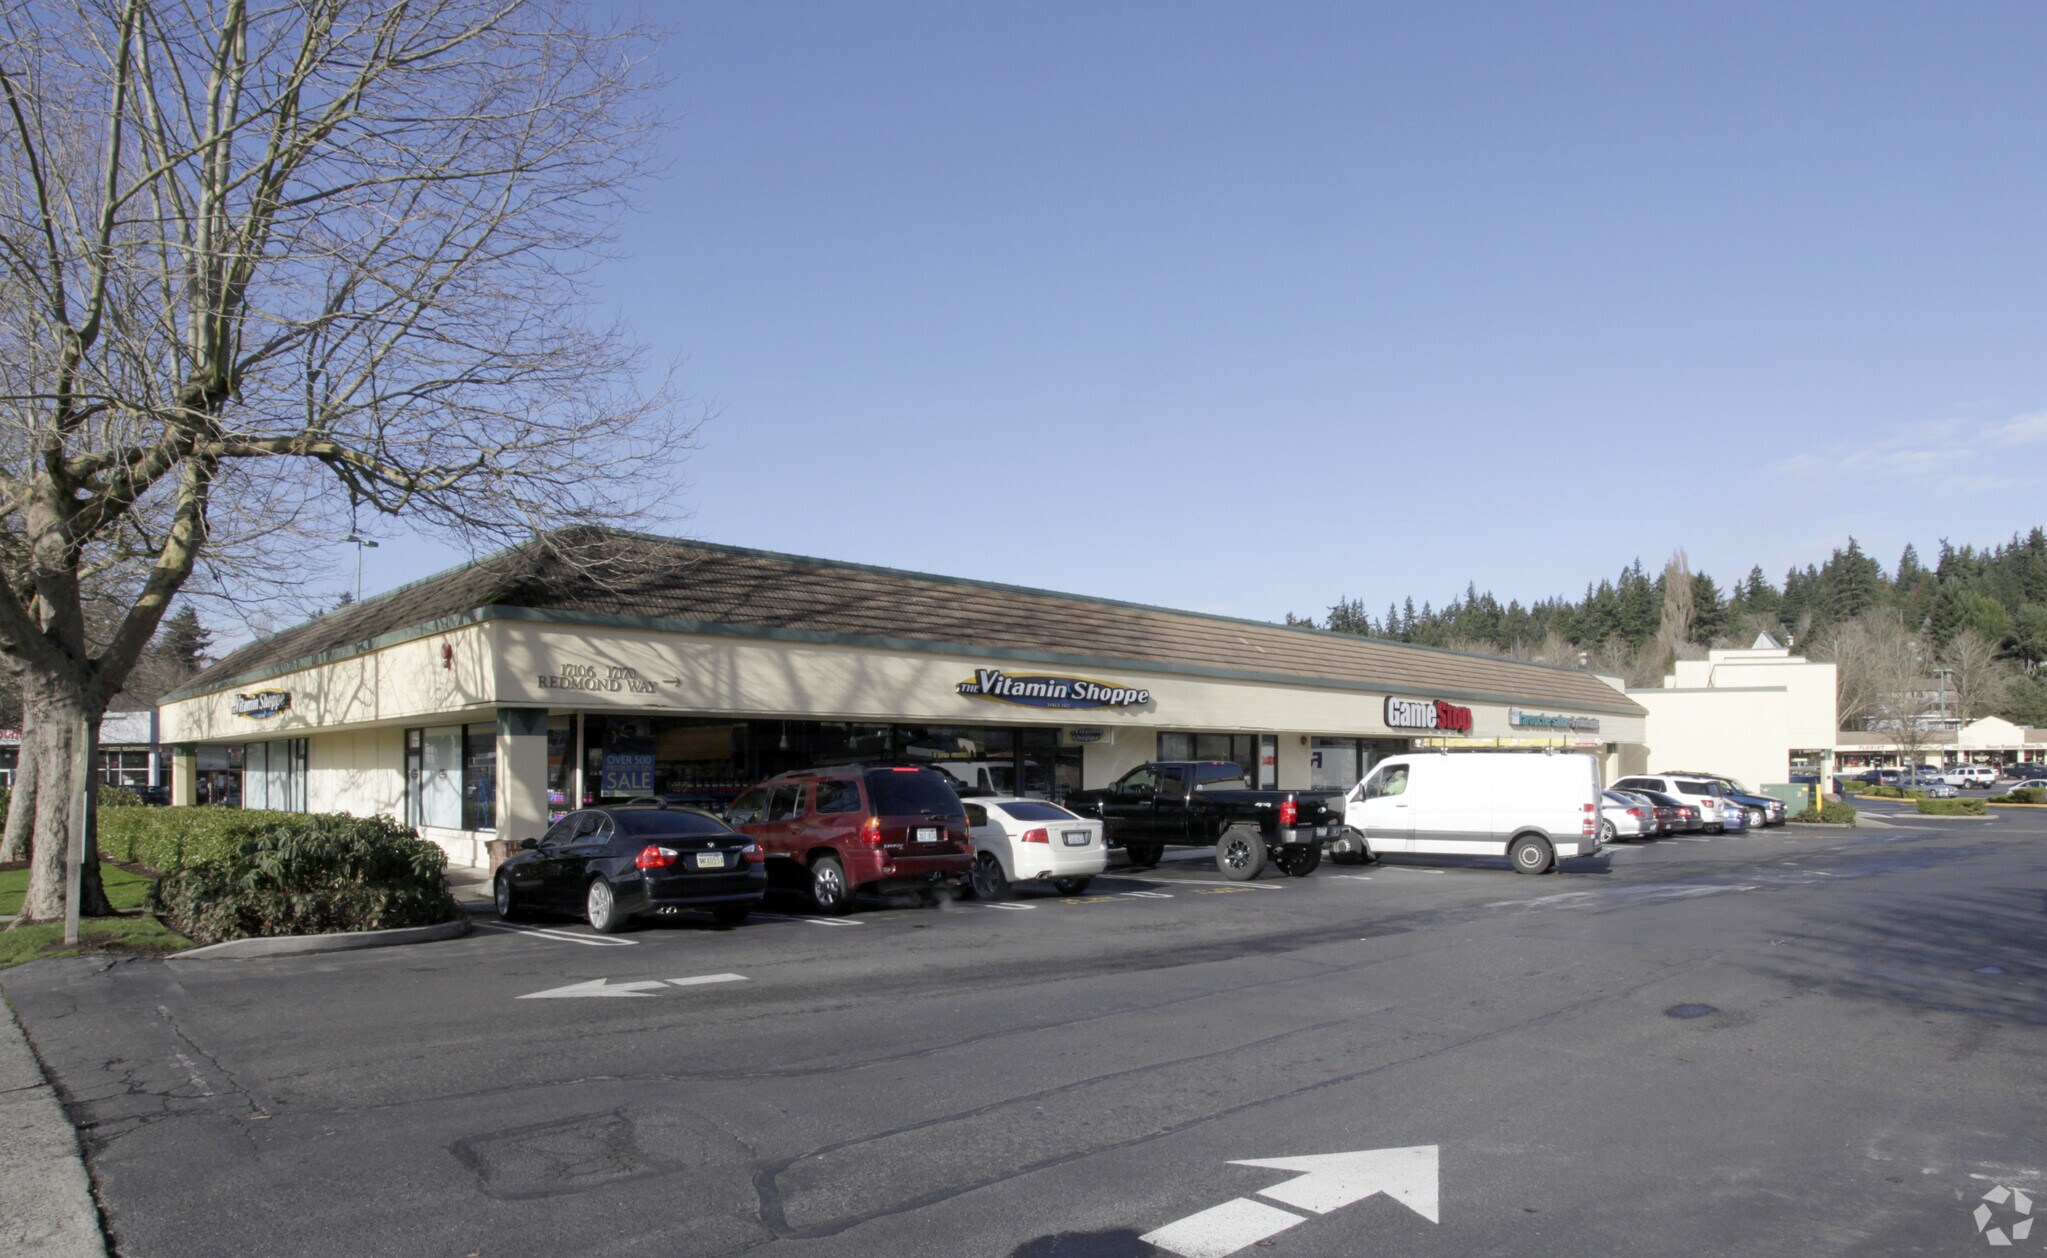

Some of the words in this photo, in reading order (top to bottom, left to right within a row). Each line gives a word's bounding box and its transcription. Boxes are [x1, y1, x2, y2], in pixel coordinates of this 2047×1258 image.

[561, 664, 597, 678] 17106
[537, 675, 622, 692] REDMOND
[626, 679, 660, 693] WAY
[961, 683, 979, 693] THE
[979, 669, 1068, 698] Vitamin
[1071, 681, 1149, 705] Shoppe
[1388, 696, 1472, 732] GameStop
[607, 755, 633, 765] OVER
[634, 755, 652, 765] 500
[607, 772, 652, 789] SALE
